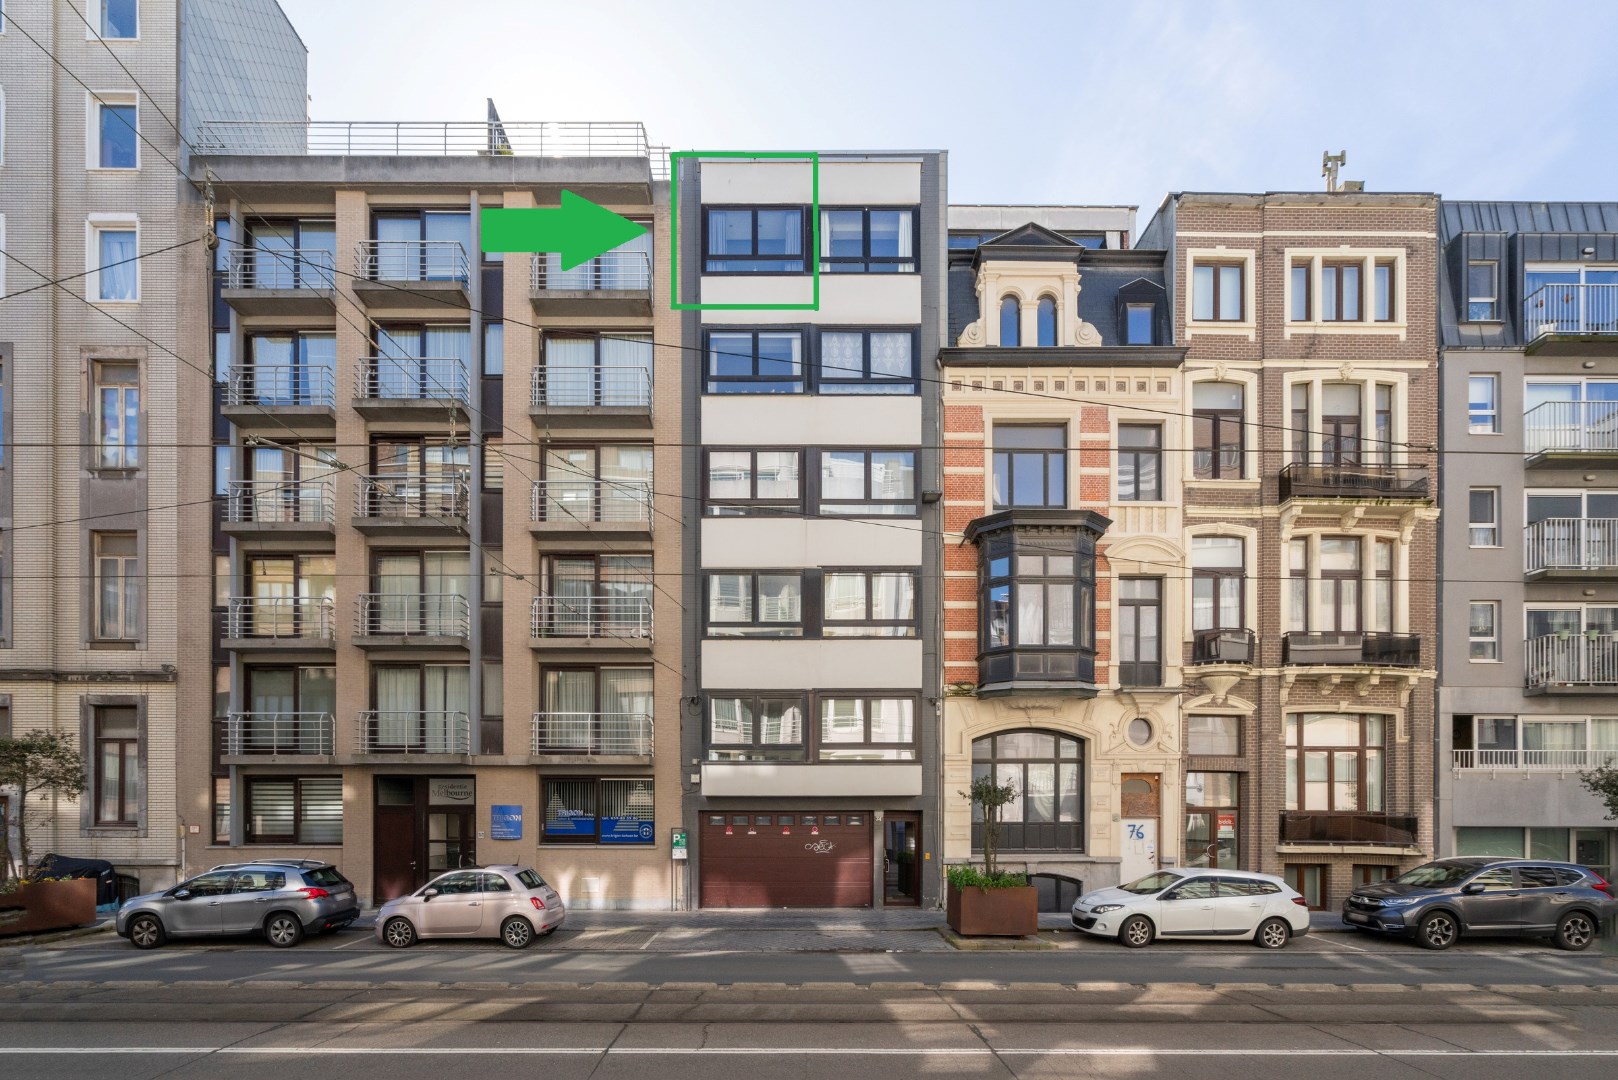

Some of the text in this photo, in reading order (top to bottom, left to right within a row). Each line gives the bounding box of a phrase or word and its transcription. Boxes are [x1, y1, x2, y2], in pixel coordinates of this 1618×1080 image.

[432, 789, 472, 797] Melbourne
[1128, 824, 1144, 840] 76
[674, 834, 680, 842] P
